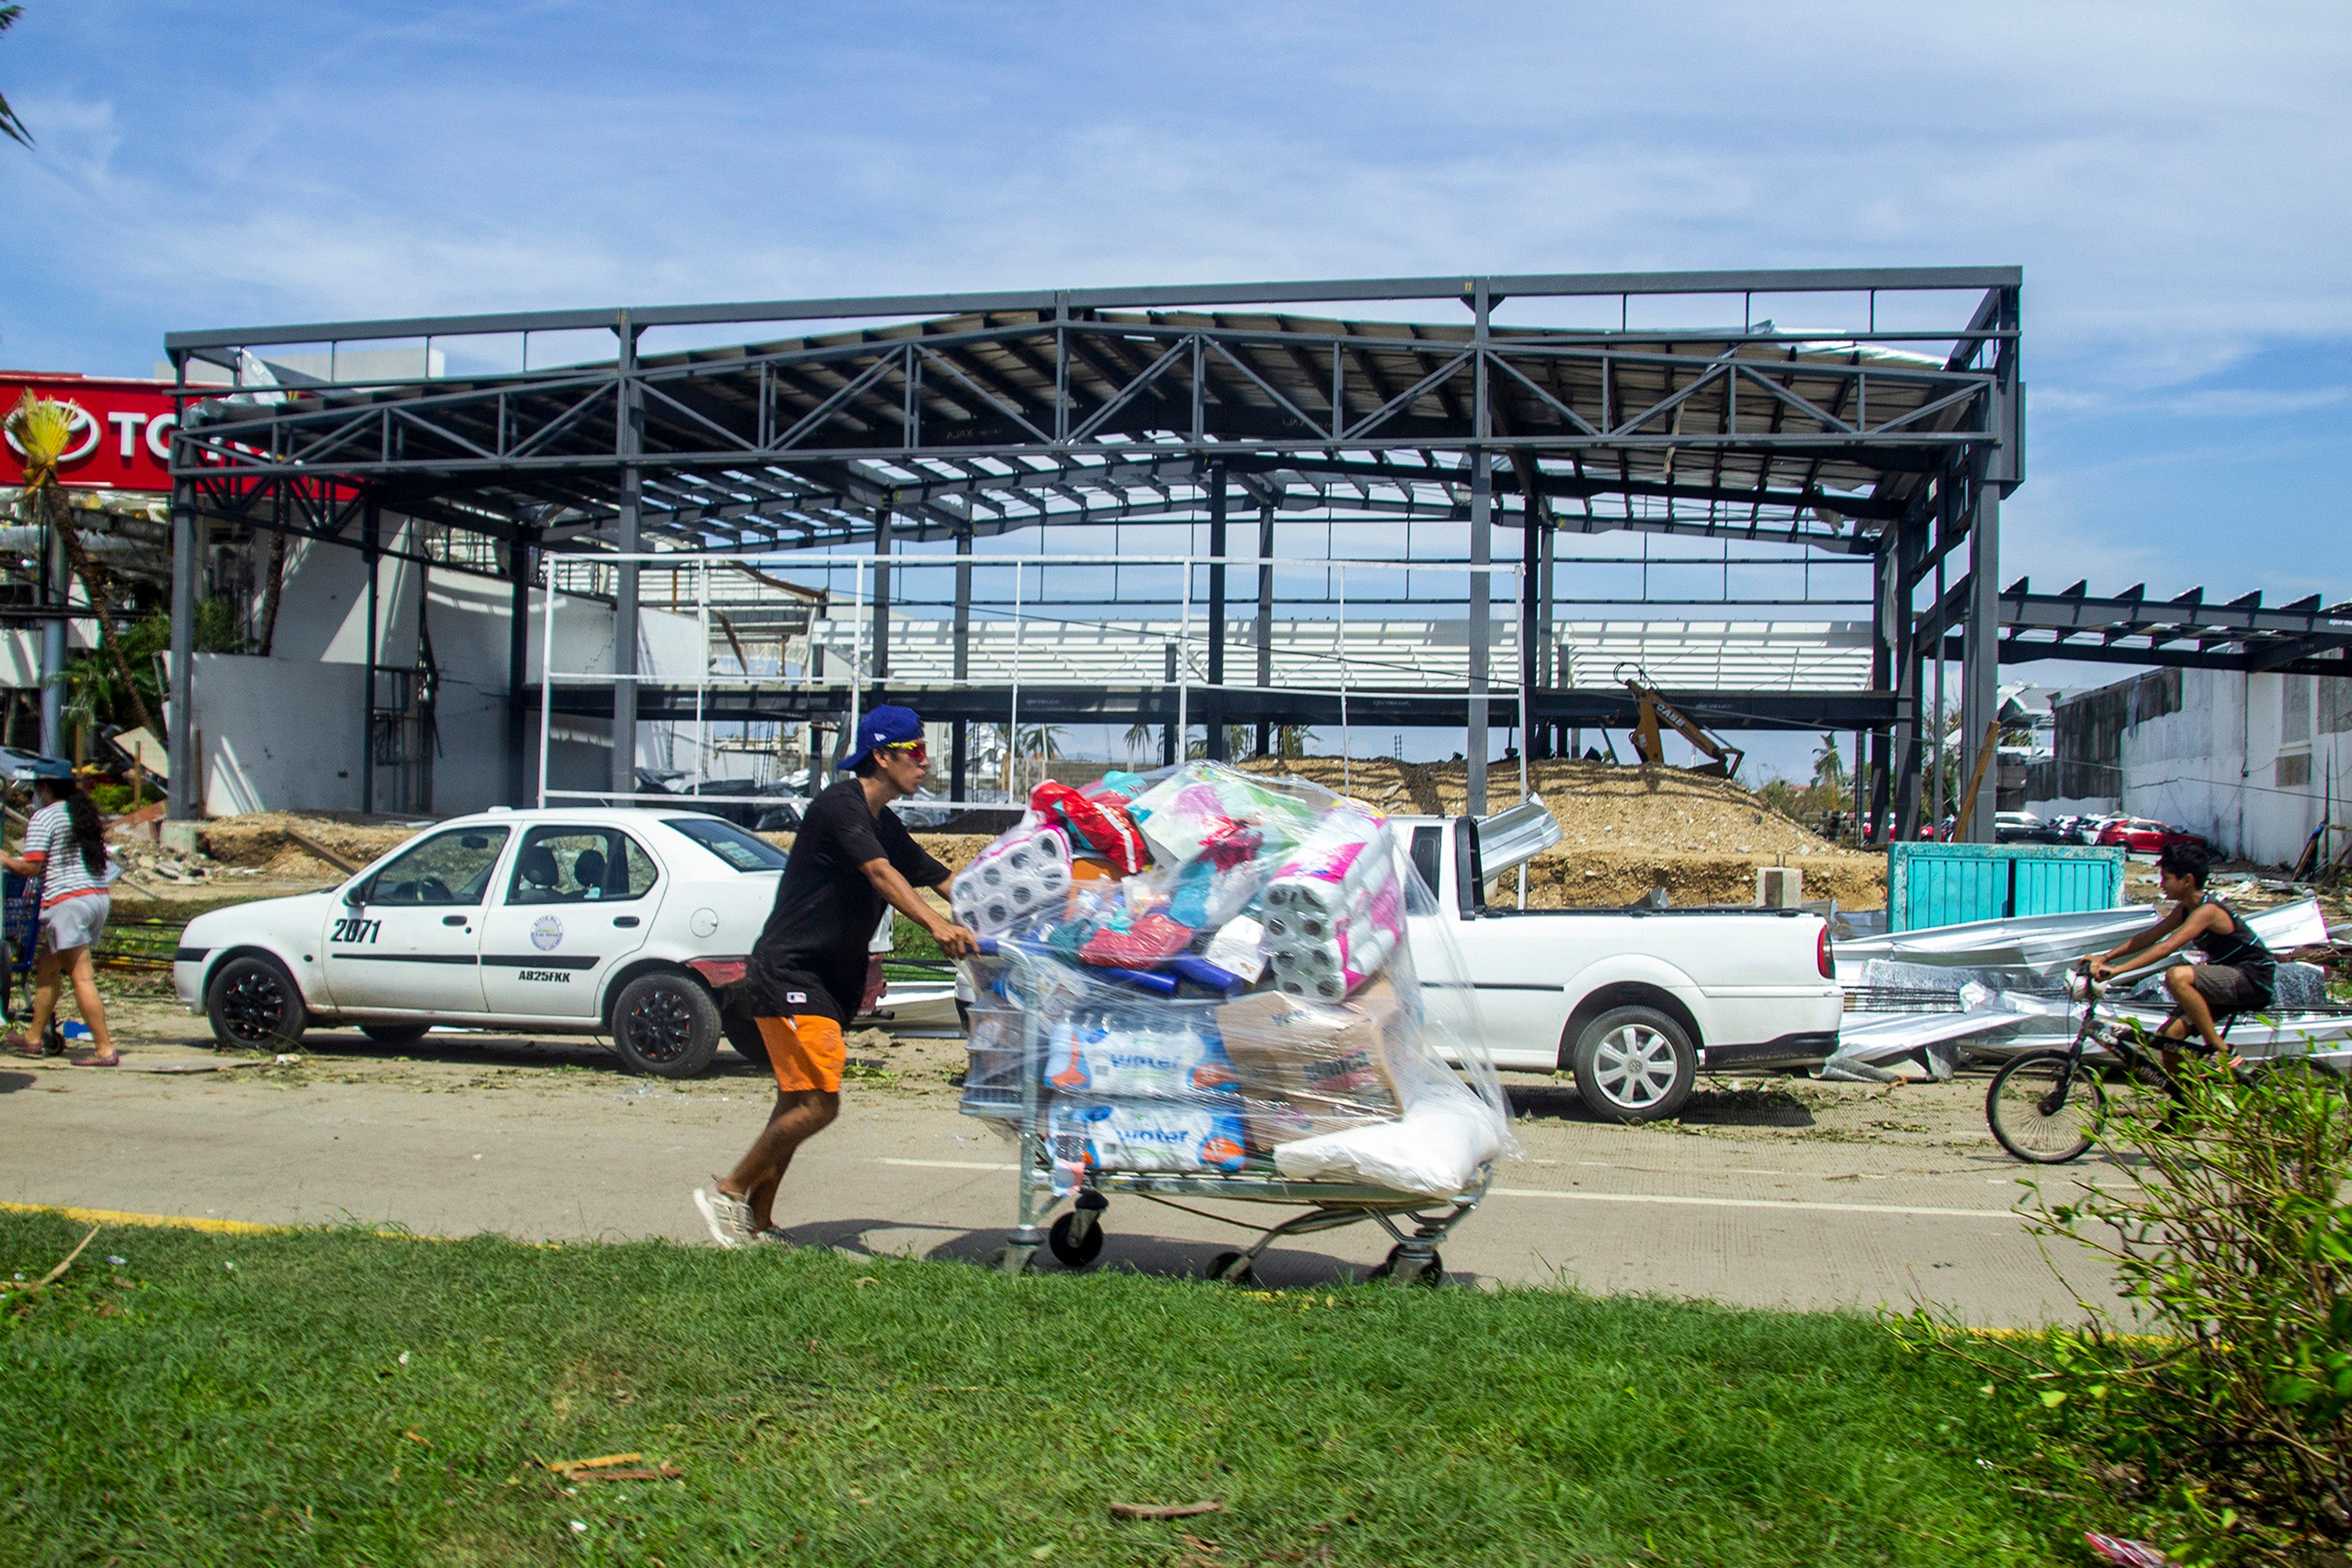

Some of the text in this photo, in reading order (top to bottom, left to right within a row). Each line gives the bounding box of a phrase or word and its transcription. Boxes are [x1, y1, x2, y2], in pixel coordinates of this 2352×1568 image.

[1657, 704, 1686, 728] CASE
[330, 919, 382, 943] 2071
[518, 971, 571, 983] A825FKK
